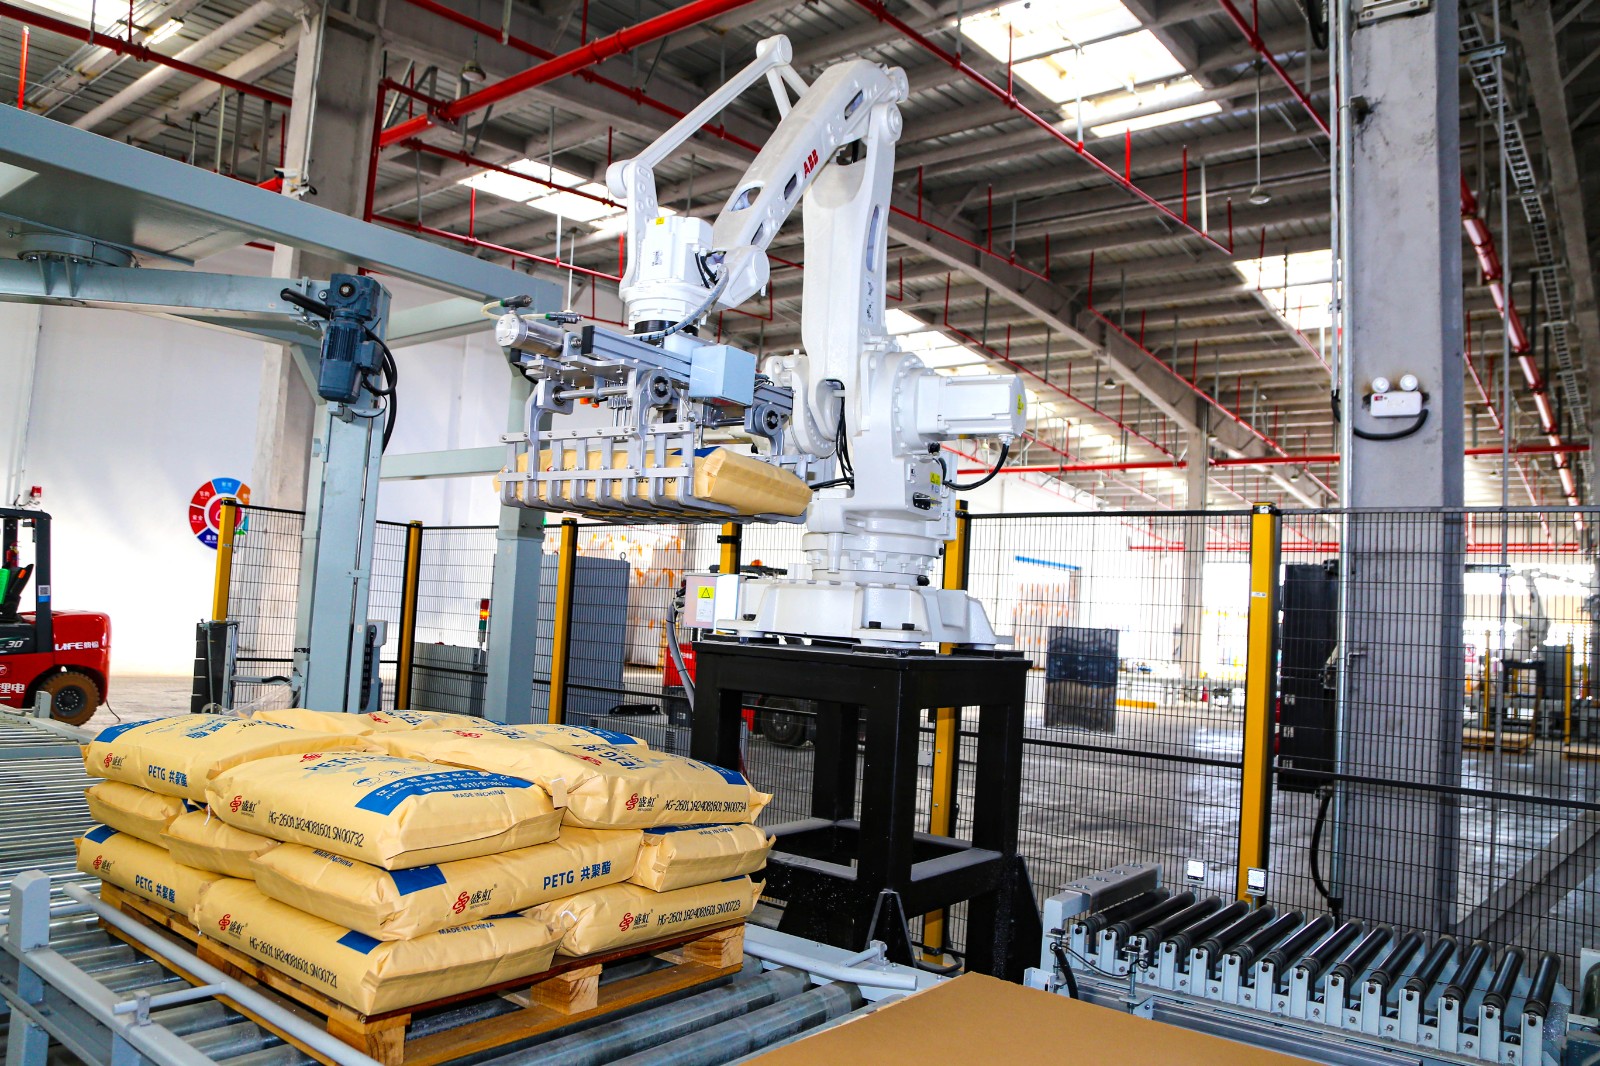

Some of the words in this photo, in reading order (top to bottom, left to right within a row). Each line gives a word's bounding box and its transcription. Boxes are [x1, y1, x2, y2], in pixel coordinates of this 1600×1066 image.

[803, 148, 819, 180] ABB
[148, 764, 166, 781] PETG
[332, 826, 365, 848] SN00732
[135, 874, 153, 892] PETG
[543, 870, 575, 890] PETG
[580, 860, 612, 882] 共聚酯
[469, 887, 494, 906] 盛虹
[438, 926, 462, 935] MADE
[472, 922, 496, 930] CHINA
[657, 912, 683, 927] HG-2601
[249, 936, 274, 958] HG-2601
[309, 963, 338, 989] SN00721
